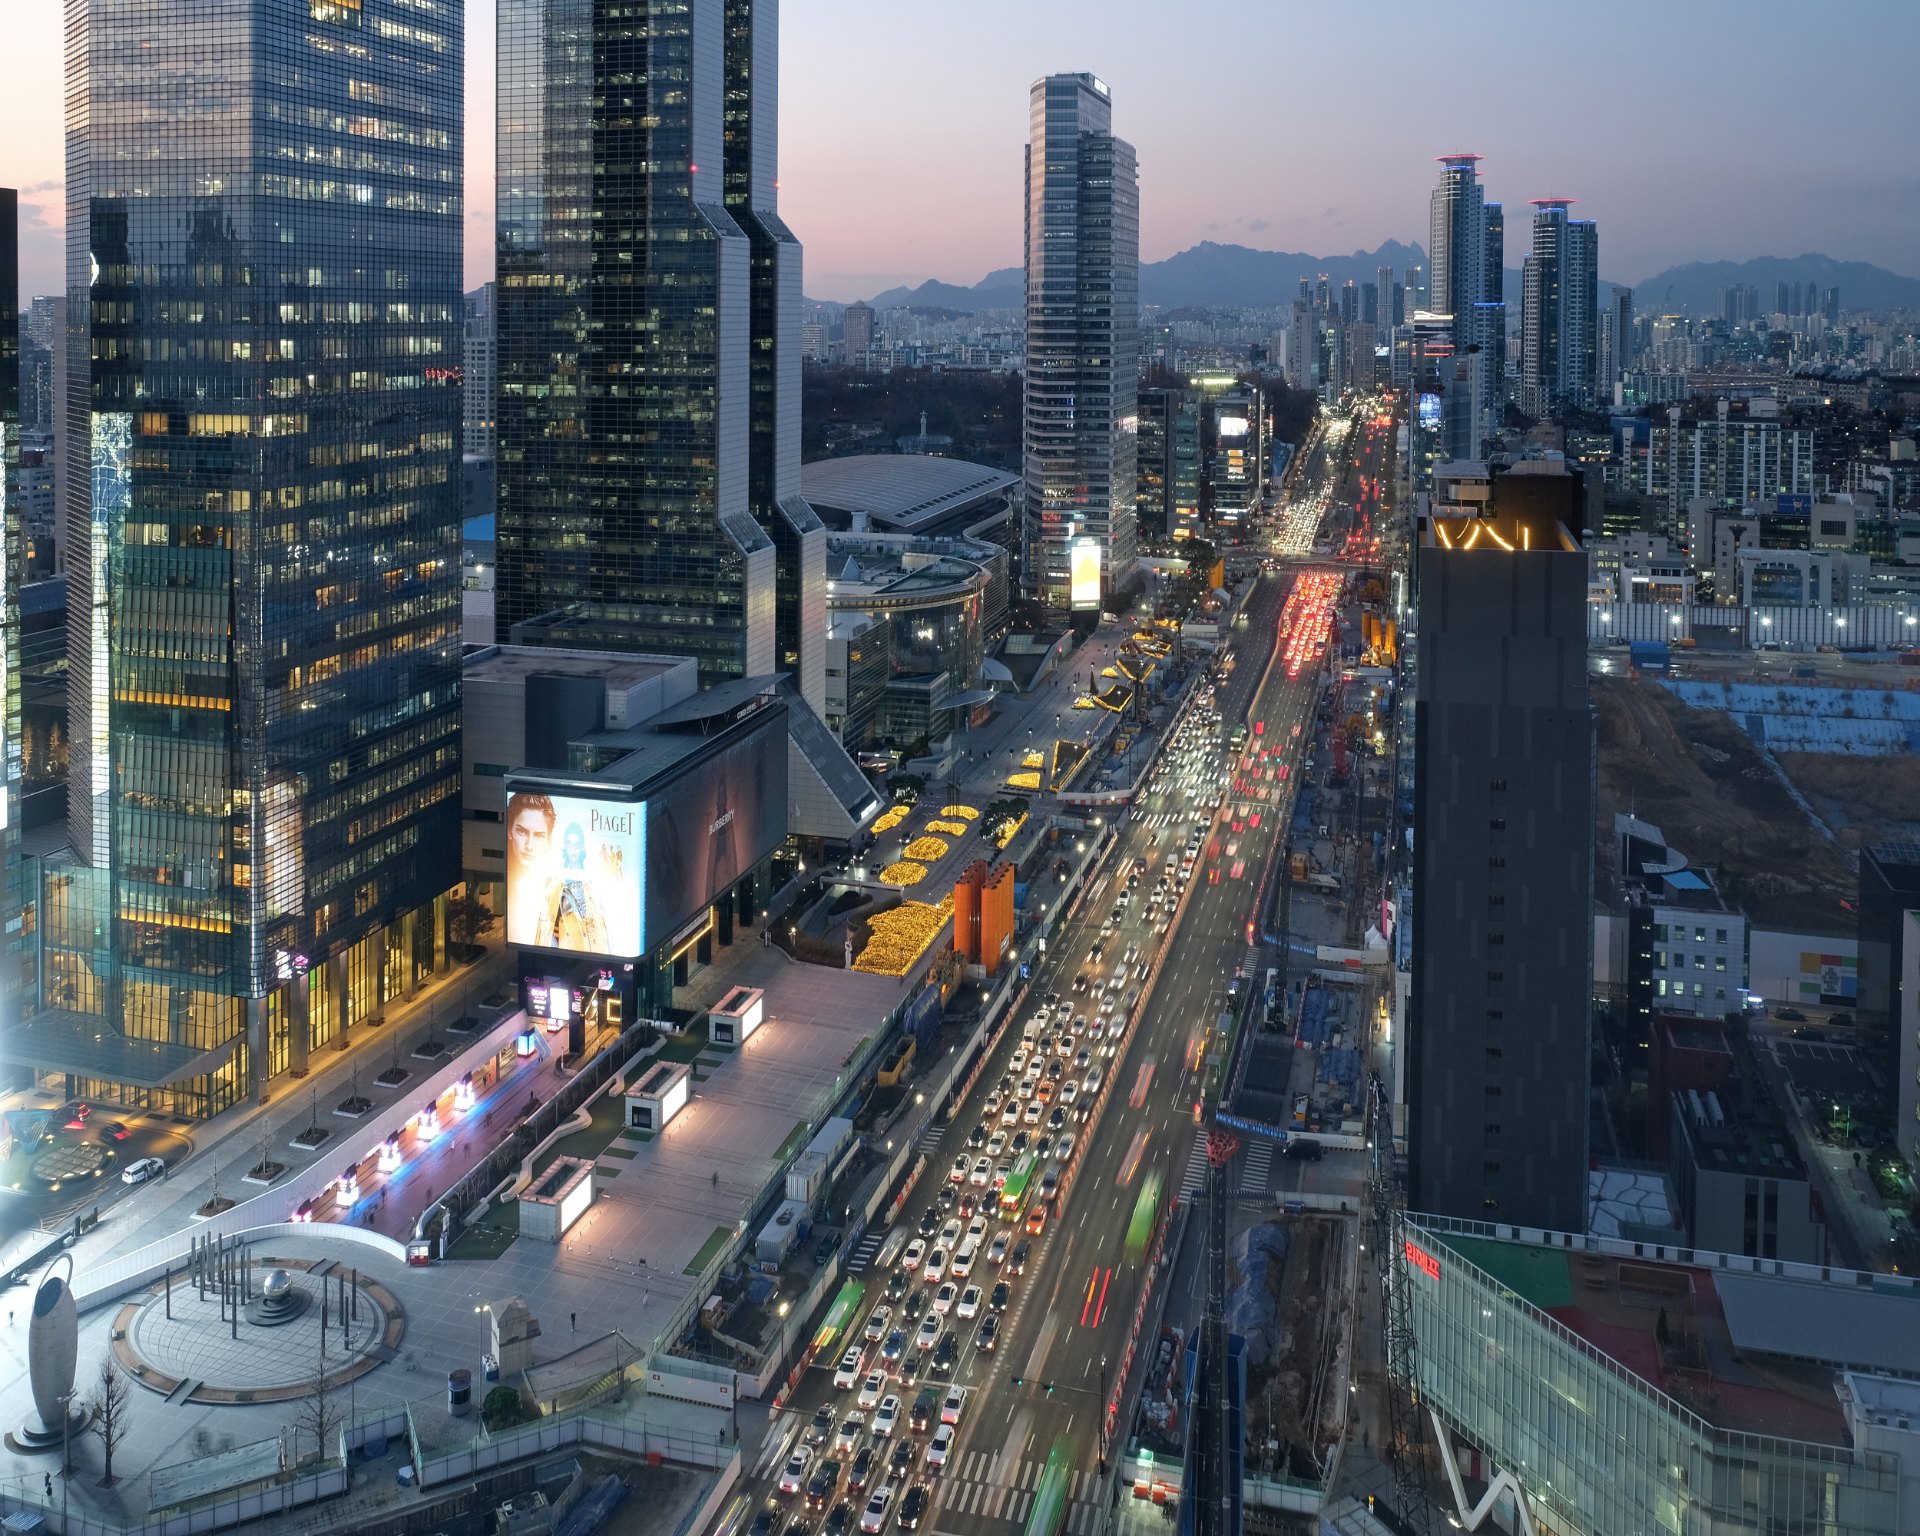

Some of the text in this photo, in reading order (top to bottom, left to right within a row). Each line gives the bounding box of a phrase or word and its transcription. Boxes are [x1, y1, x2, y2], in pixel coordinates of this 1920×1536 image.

[591, 809, 635, 835] PIAGET
[709, 808, 735, 836] BURBERRY
[1405, 1240, 1441, 1281] 위메프
